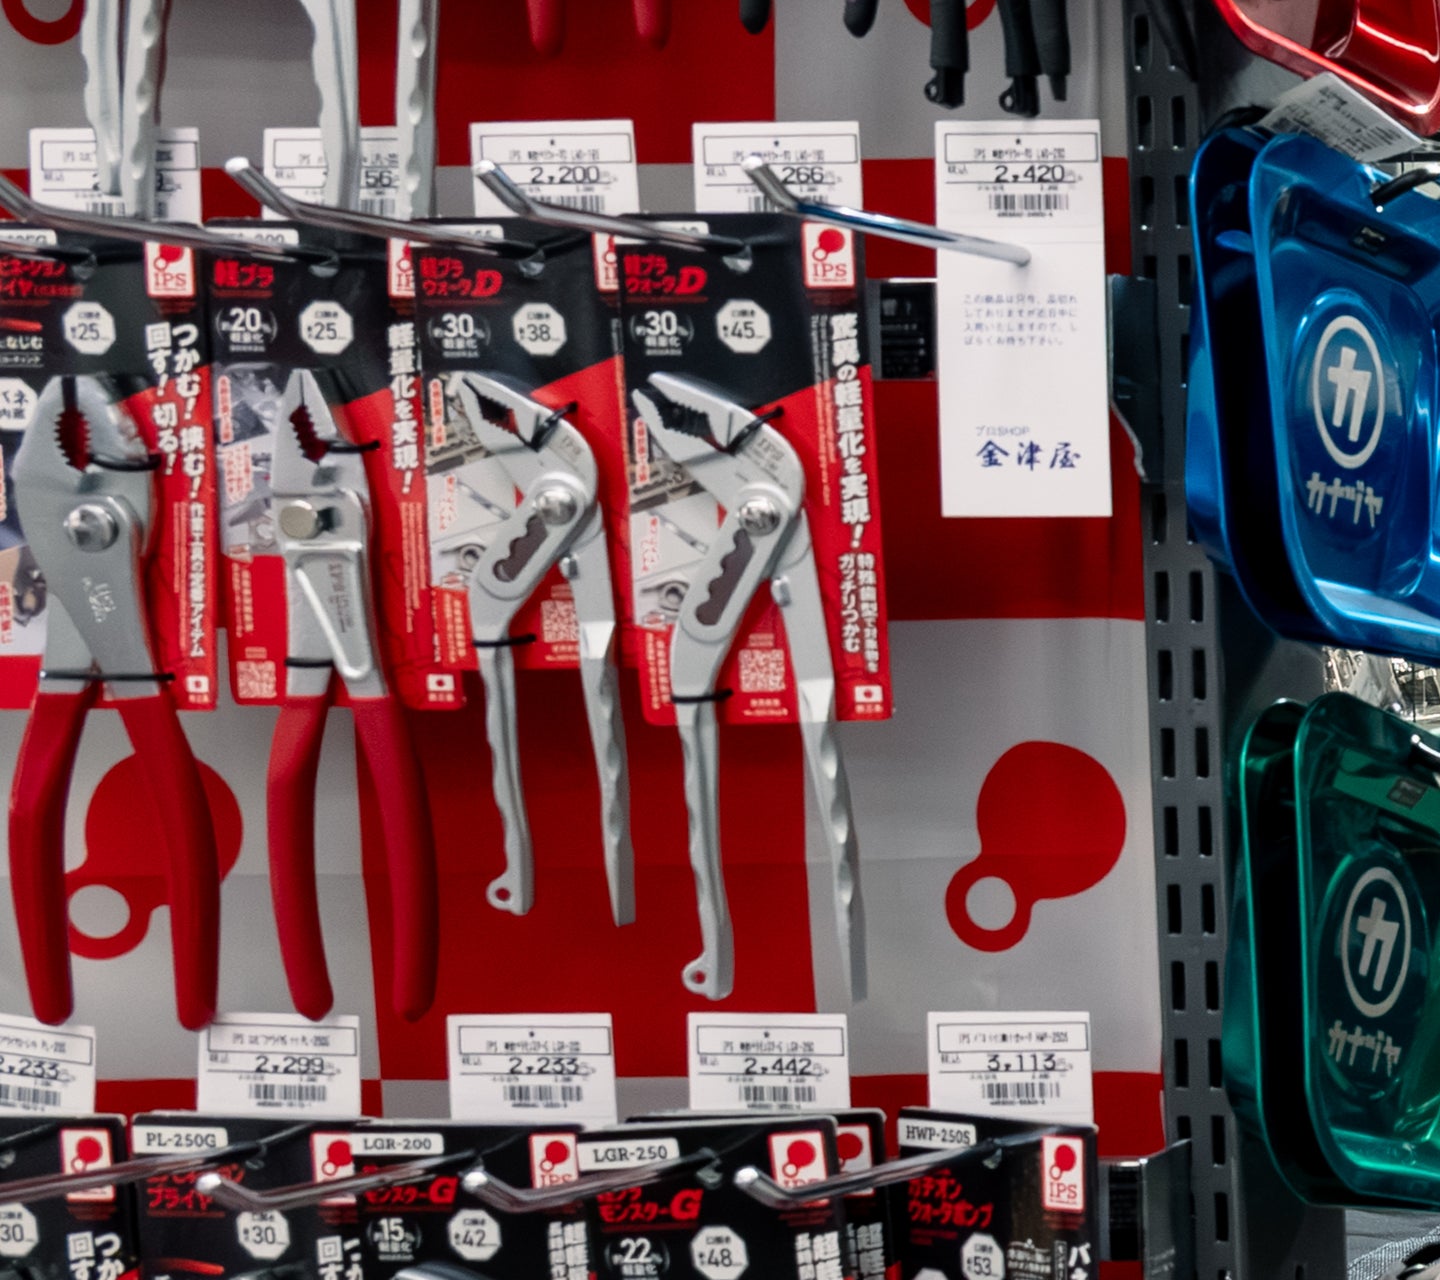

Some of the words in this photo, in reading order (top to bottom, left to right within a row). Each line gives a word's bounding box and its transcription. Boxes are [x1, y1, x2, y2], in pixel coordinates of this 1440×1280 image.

[153, 272, 188, 287] IPS
[812, 262, 848, 279] IPS
[975, 440, 1081, 471] 金津屋
[145, 1132, 218, 1150] PL-250G
[362, 1136, 433, 1152] LGR-200
[905, 1125, 973, 1146] HWP-250S
[592, 1144, 669, 1164] LGR-250
[1048, 1182, 1079, 1200] IPS
